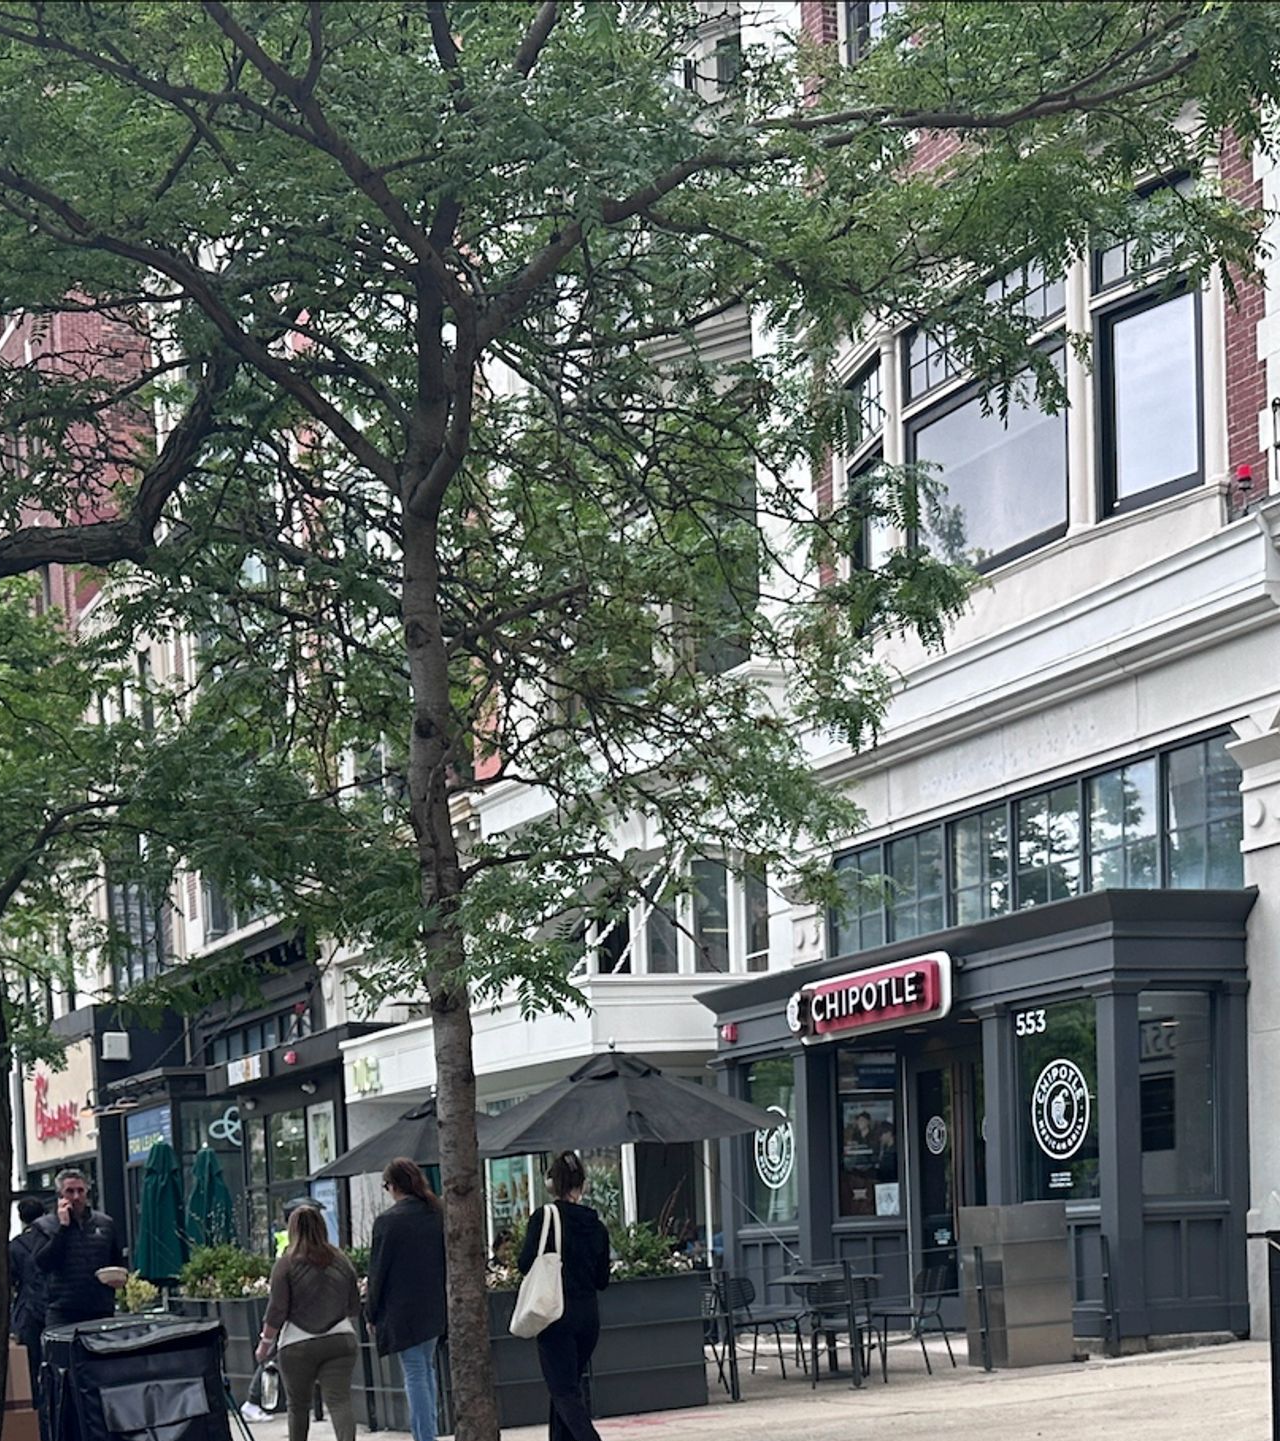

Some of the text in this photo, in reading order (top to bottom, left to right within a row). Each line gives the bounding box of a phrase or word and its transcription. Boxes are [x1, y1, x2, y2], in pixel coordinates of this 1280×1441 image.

[811, 971, 918, 1023] CHIPOTLE
[1015, 1008, 1047, 1037] 553
[1036, 1065, 1086, 1105] CHIPOTLE
